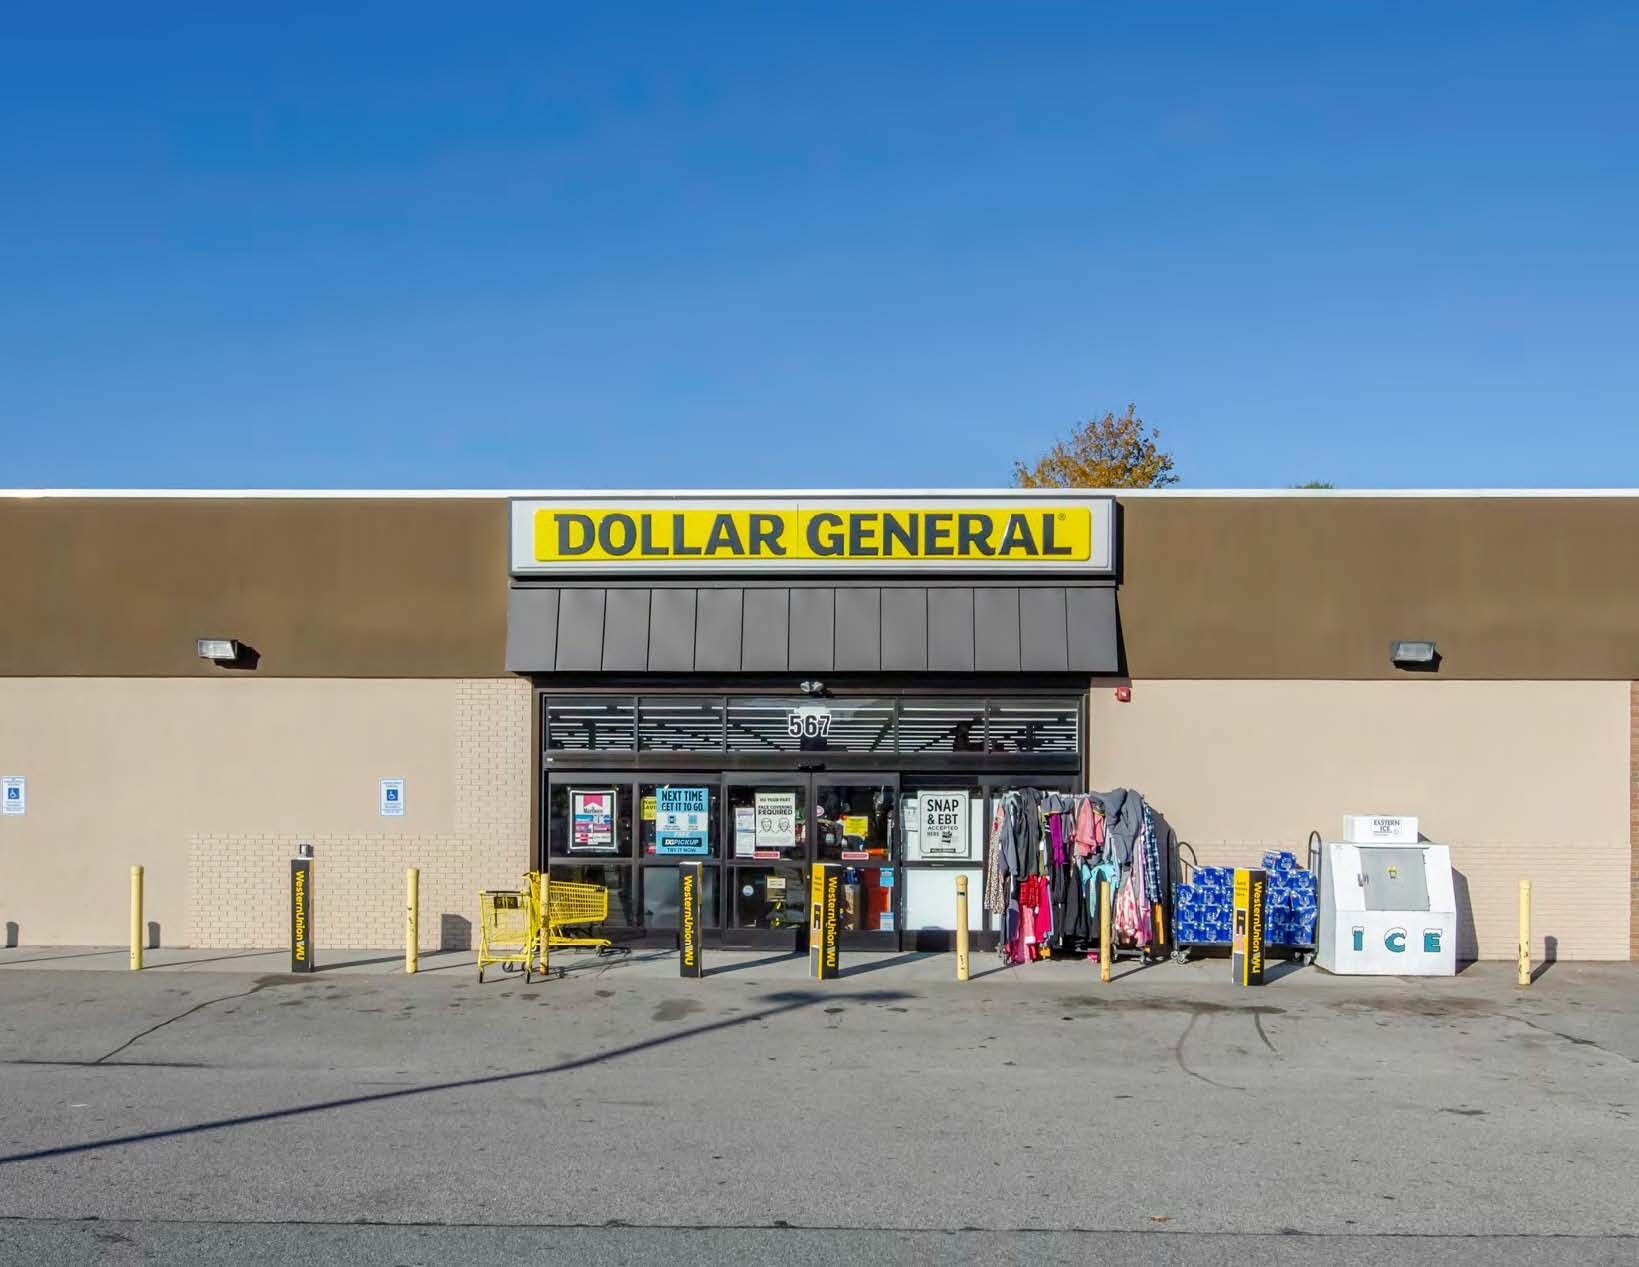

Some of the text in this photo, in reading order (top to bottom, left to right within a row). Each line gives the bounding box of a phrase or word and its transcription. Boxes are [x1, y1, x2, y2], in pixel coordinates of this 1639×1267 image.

[554, 513, 787, 556] DOLLAR
[788, 714, 831, 737] 567
[661, 791, 703, 801] NEXT TIME
[661, 803, 674, 811] GET
[675, 803, 682, 811] IT
[683, 803, 692, 811] TO
[927, 799, 959, 812] SNAP
[927, 814, 935, 825] &
[938, 814, 958, 825] EBT
[296, 871, 305, 940] WesternUnion
[684, 875, 693, 945] WesternUnion
[826, 876, 838, 947] WesternUnion
[1252, 881, 1263, 953] WesternUnion
[1352, 925, 1443, 954] ICE
